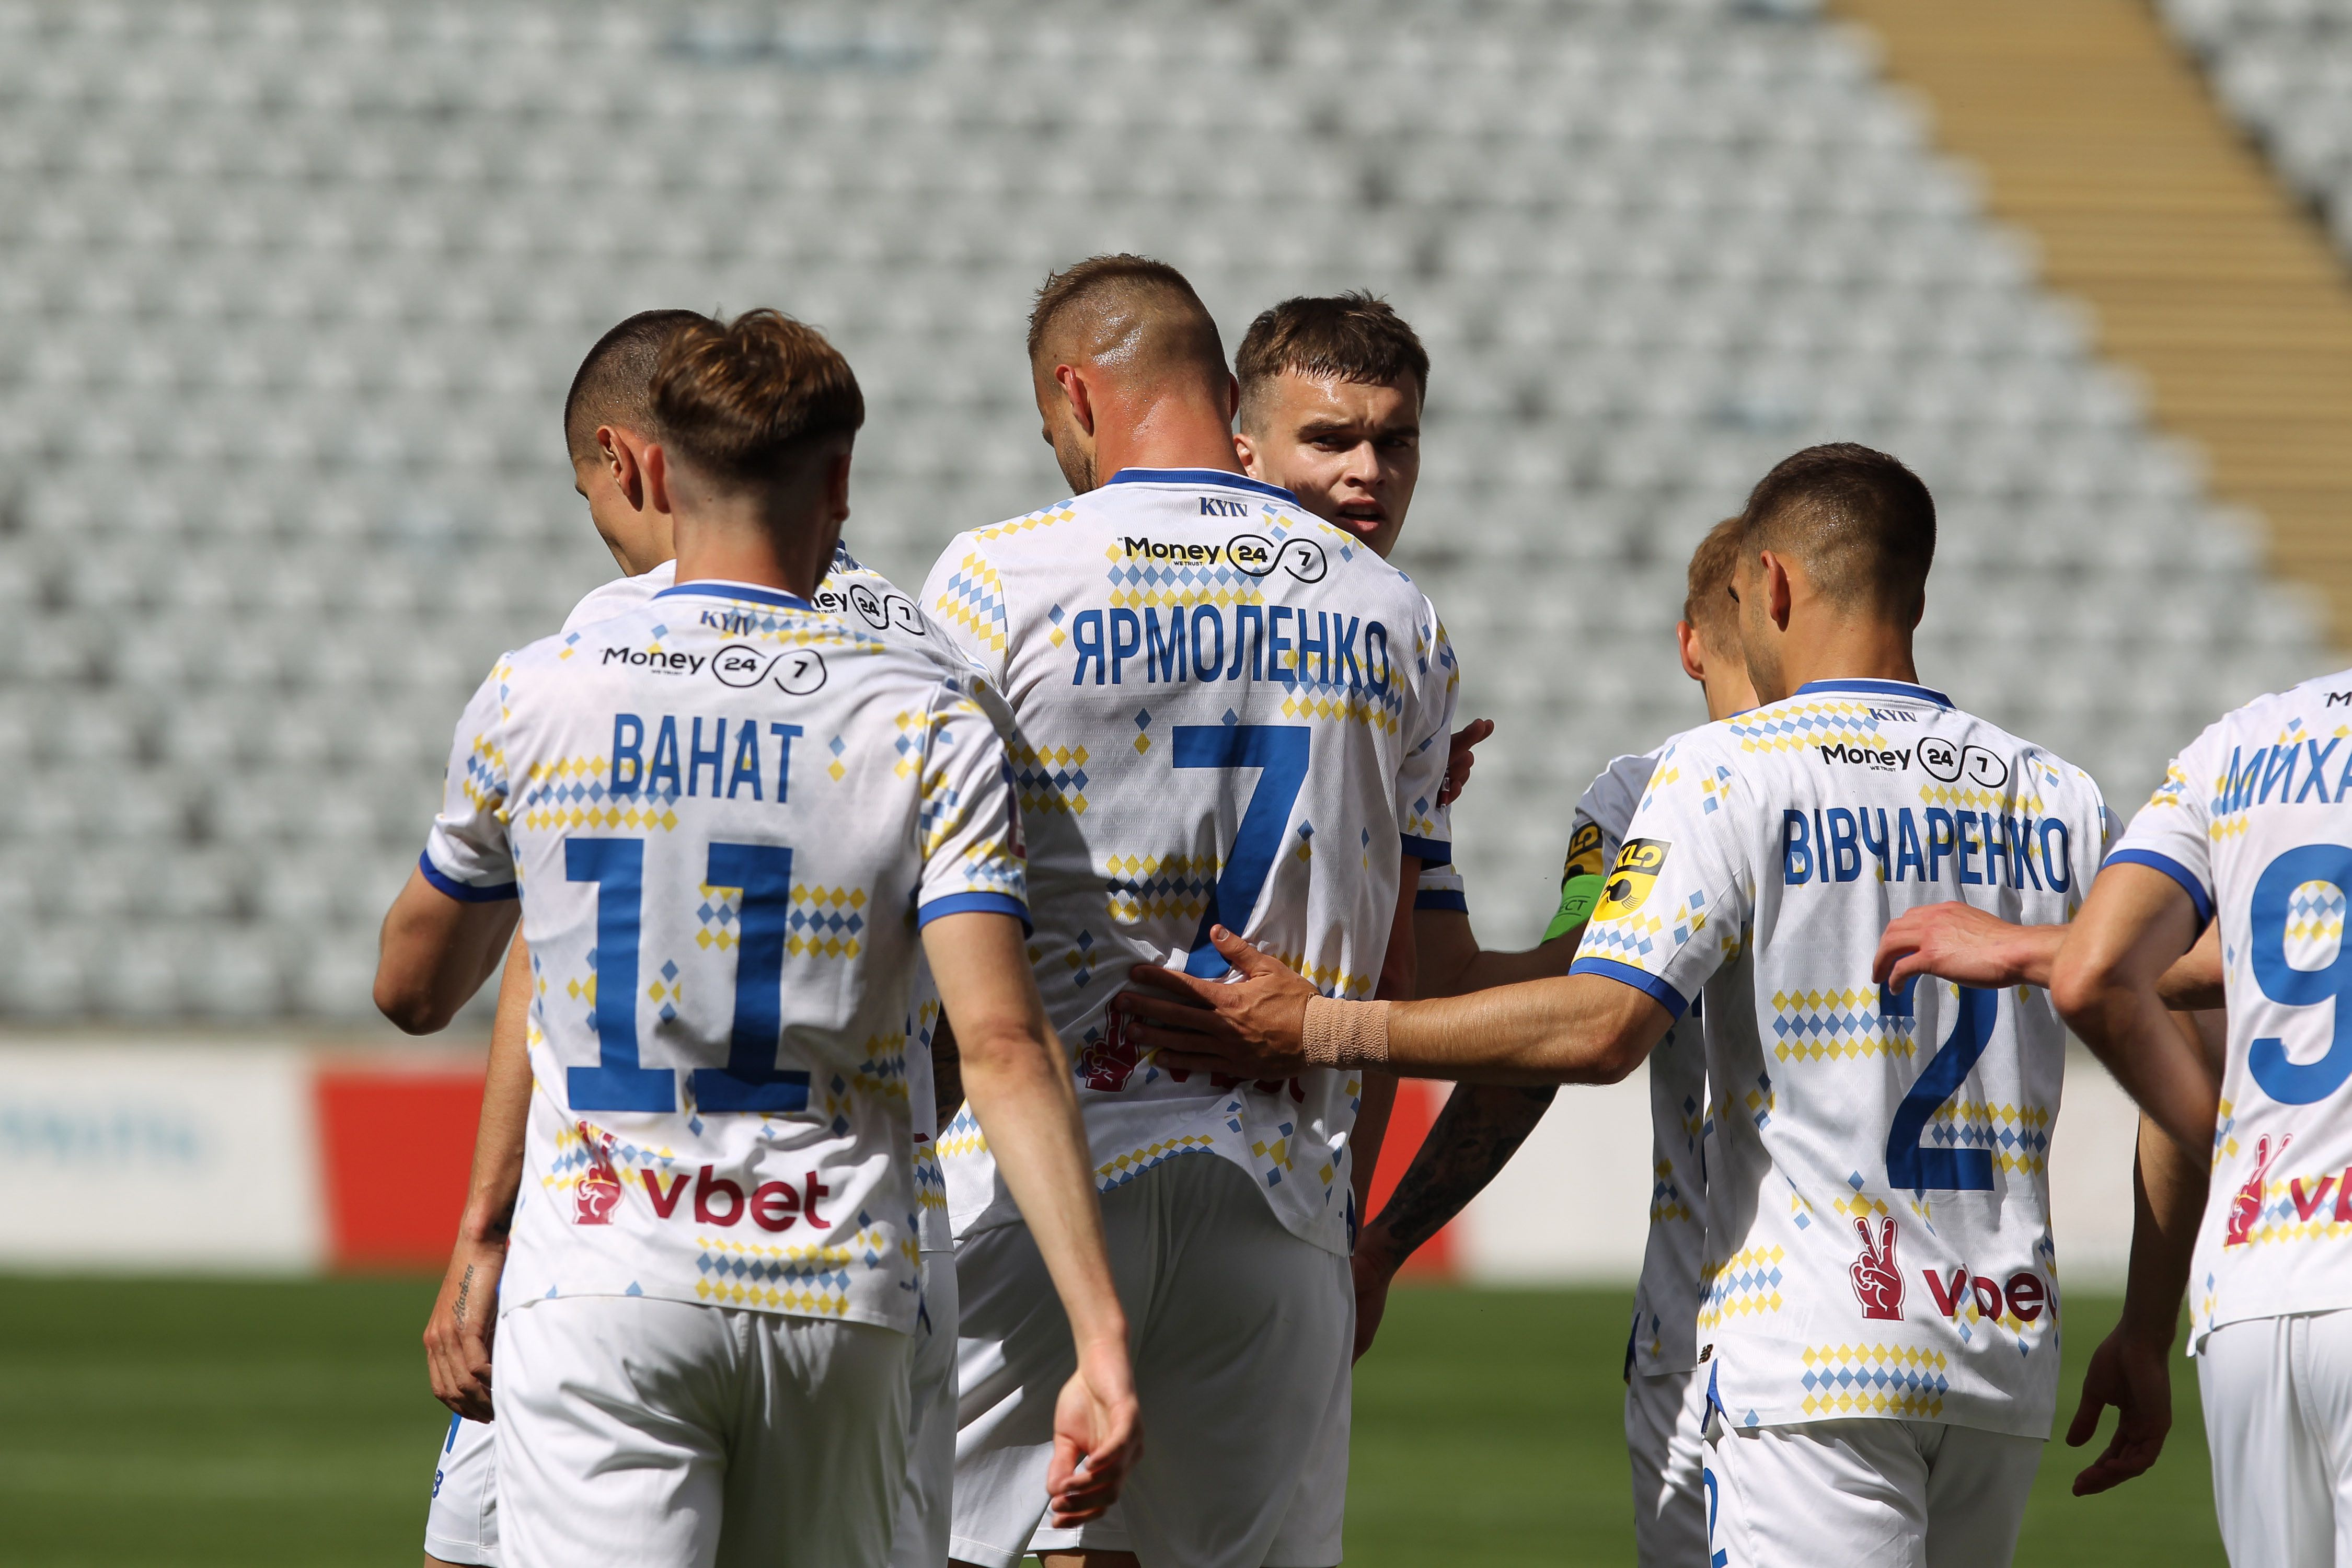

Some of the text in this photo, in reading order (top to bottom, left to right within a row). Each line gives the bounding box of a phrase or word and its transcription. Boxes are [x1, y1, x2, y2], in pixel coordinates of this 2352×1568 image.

[1199, 497, 1248, 516] KYIV
[1124, 536, 1221, 564] Money
[1238, 545, 1268, 562] 24
[1298, 550, 1311, 567] 7
[700, 610, 755, 637] KYIV
[858, 597, 881, 617] 24
[898, 606, 910, 620] 7
[602, 648, 808, 678] Money 24 7
[1072, 604, 1390, 696] ЯРМОЛЕНКО
[1867, 708, 1918, 722] KYIV
[610, 713, 803, 803] ВАНАТ
[1820, 744, 1912, 770] Money
[1927, 748, 1954, 767] 24
[1976, 756, 1988, 773] 7
[1172, 725, 1311, 979] 7
[1783, 806, 2071, 893] ВІВЧАРЕНКО
[564, 838, 811, 1113] 11
[2249, 844, 2352, 1105] 9
[1881, 952, 1998, 1192] 2
[641, 1165, 831, 1232] vbet
